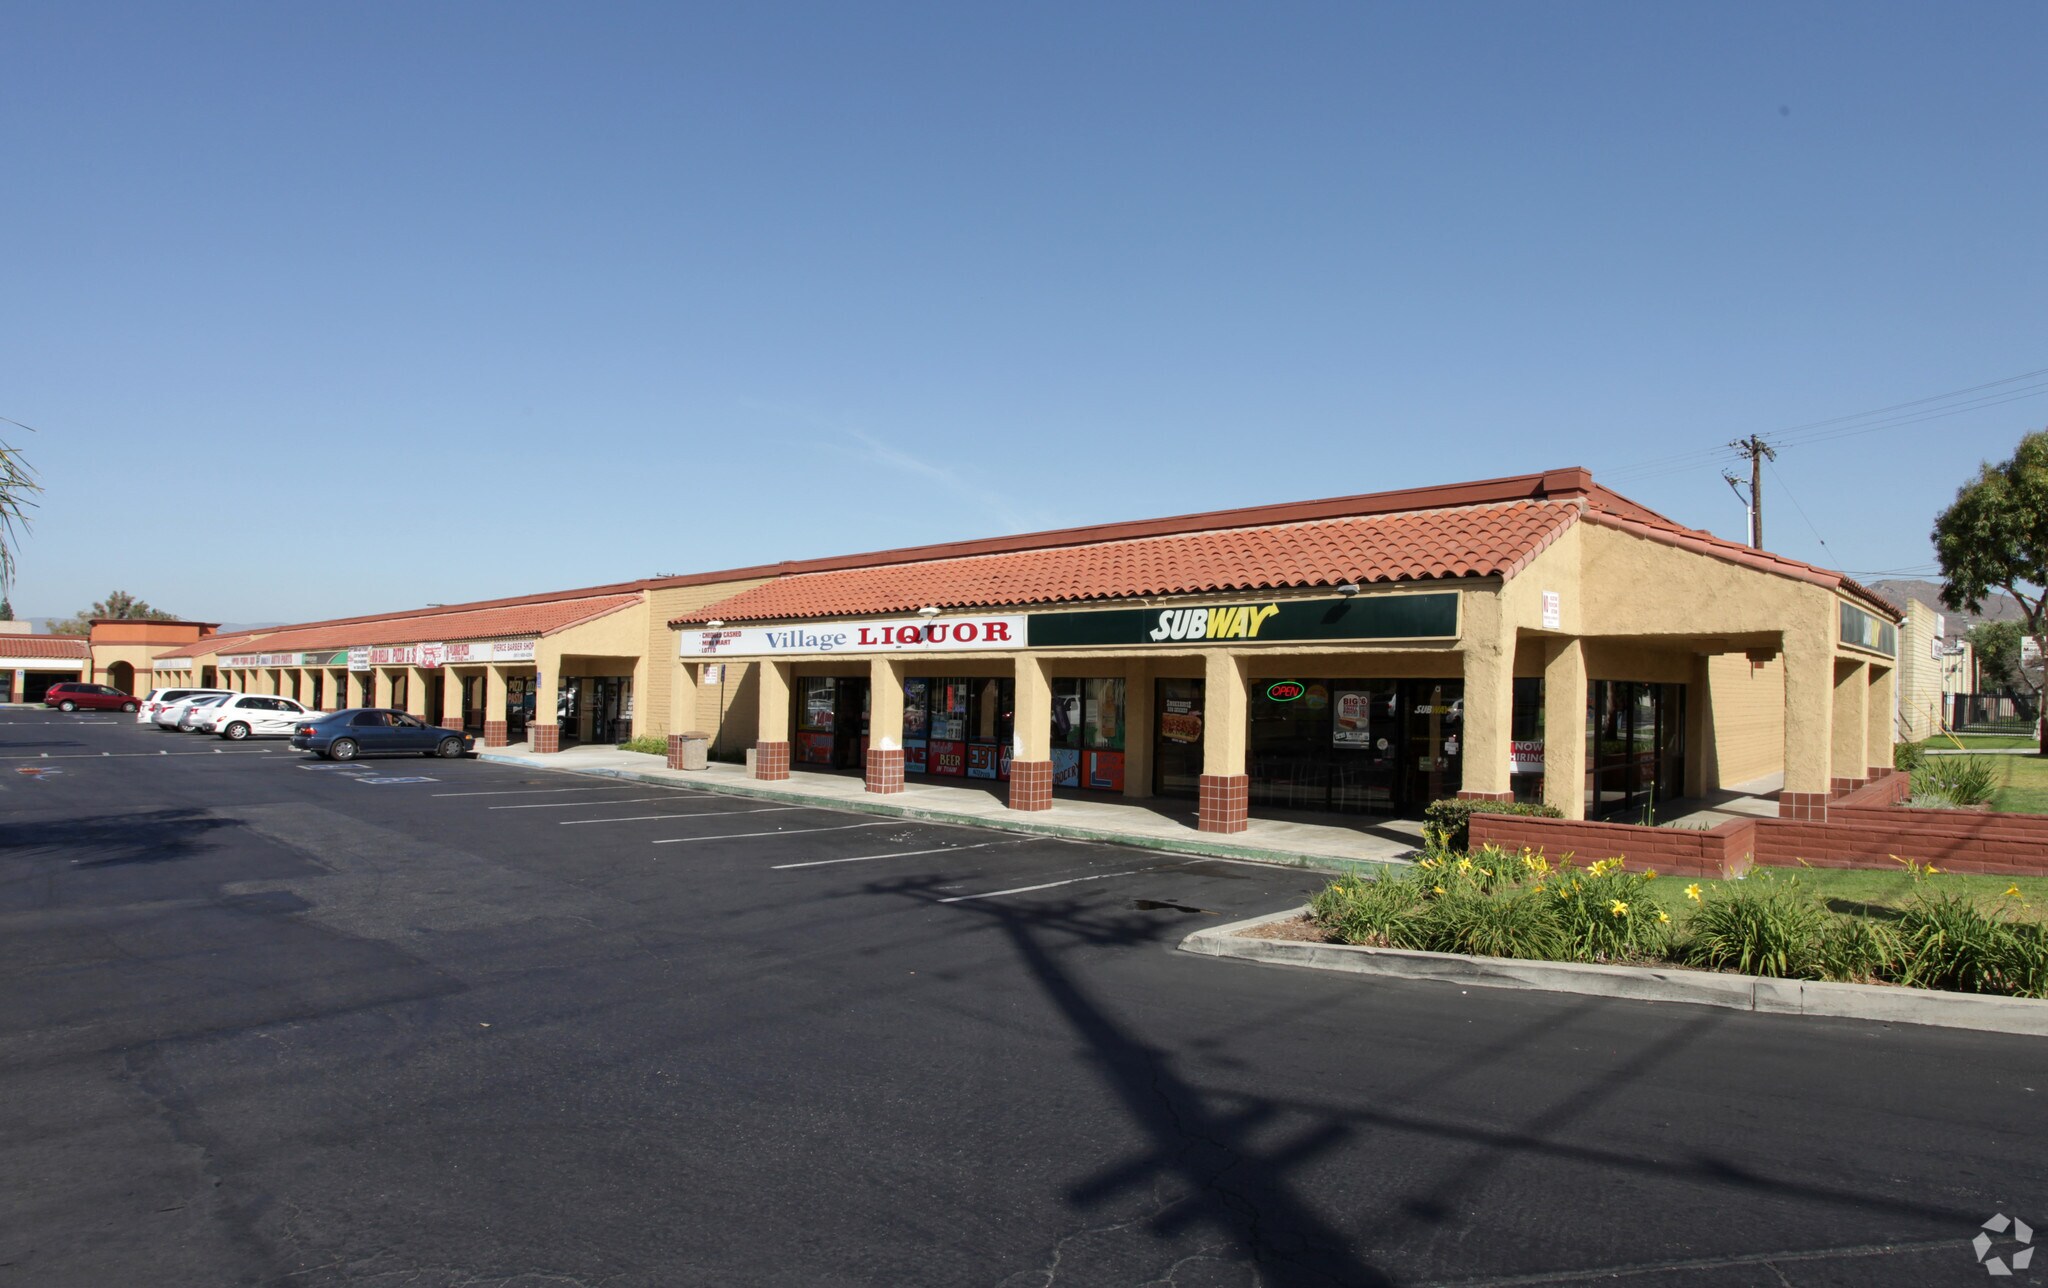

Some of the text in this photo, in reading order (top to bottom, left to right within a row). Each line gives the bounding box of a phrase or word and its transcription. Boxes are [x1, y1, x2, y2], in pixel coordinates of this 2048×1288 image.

[1149, 603, 1280, 641] SUBWAY
[766, 621, 1011, 651] Village LIQUOR
[507, 642, 523, 651] BARBER
[523, 642, 534, 650] SHOP
[1272, 685, 1299, 697] OPEN
[1414, 704, 1450, 714] SUBWAY
[1515, 742, 1543, 751] NOW
[940, 754, 960, 766] BEER
[969, 745, 997, 770] EBT
